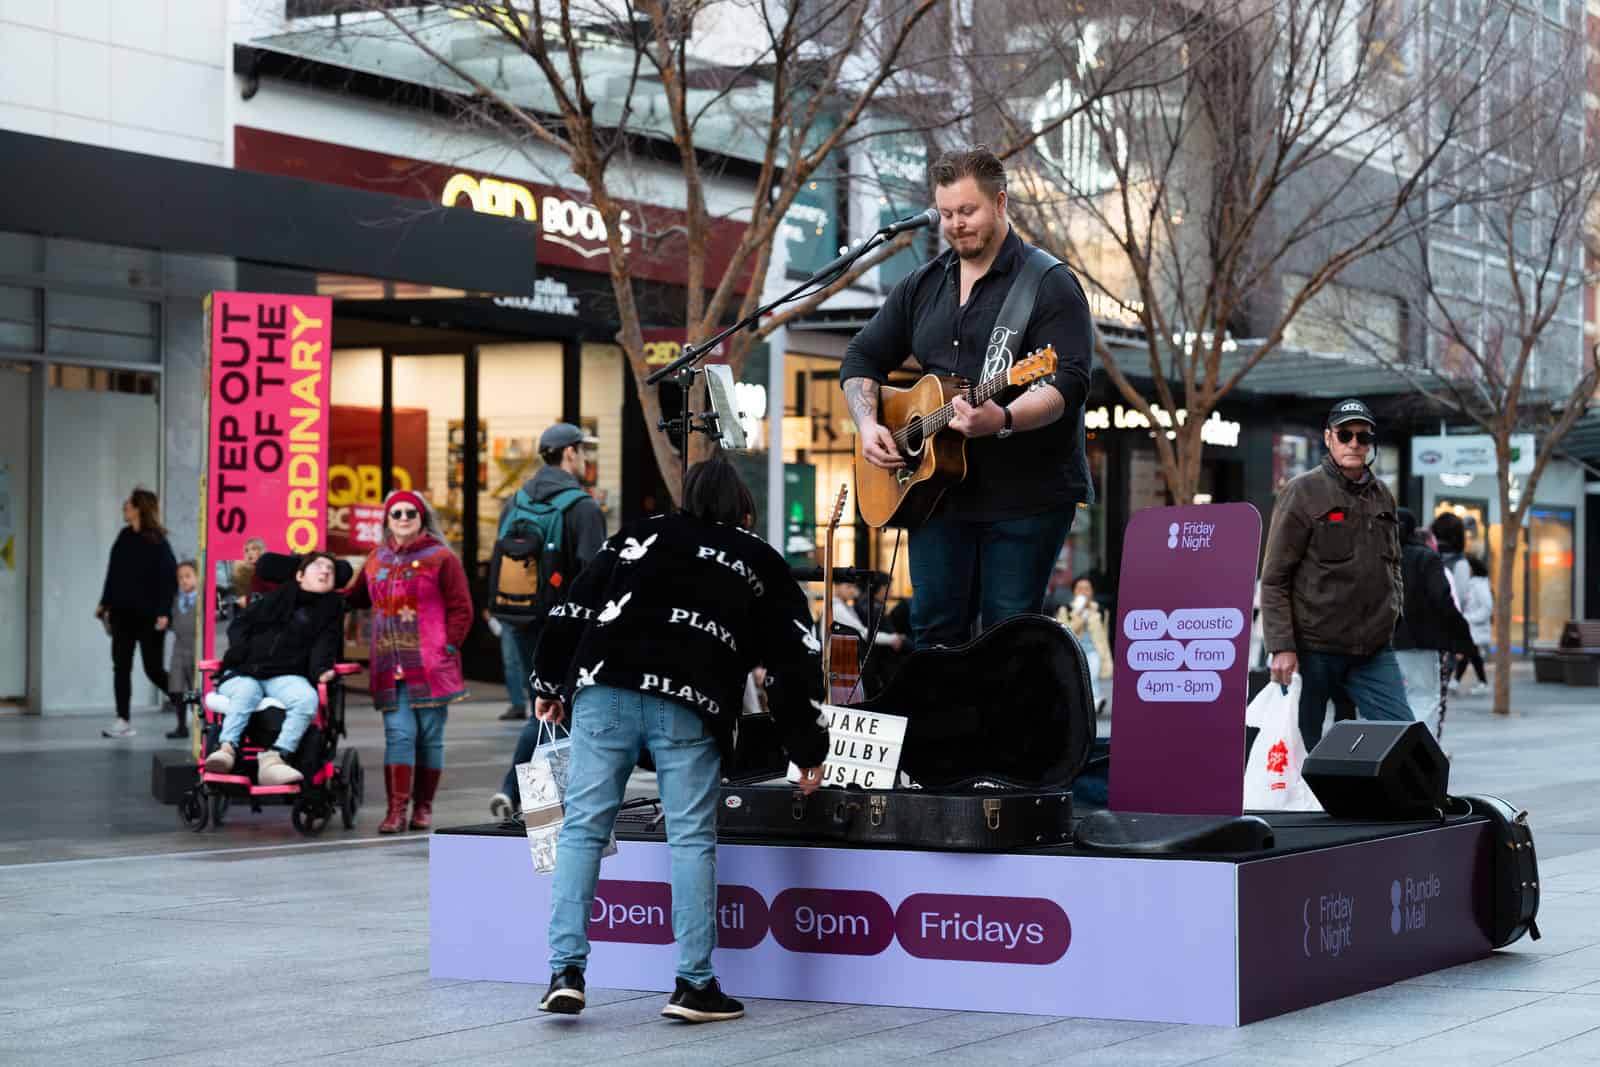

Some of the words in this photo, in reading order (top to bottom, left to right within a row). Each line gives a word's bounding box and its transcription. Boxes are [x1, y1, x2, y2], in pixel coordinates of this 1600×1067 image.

[220, 302, 251, 405] OUT
[256, 304, 286, 397] THE
[254, 410, 284, 473] OF
[286, 304, 323, 555] ORDINARY
[216, 415, 248, 534] STEP
[1181, 536, 1211, 551] Night
[1183, 522, 1215, 537] Friday
[1133, 617, 1158, 631] Live
[1176, 616, 1233, 630] acoustic
[1136, 648, 1175, 661] music
[1194, 648, 1225, 661] from
[828, 712, 879, 735] JAKE
[817, 763, 875, 788] USIC
[1404, 871, 1441, 903] Rundle
[589, 896, 664, 929] Open
[794, 905, 870, 940] 9pm
[920, 911, 1045, 950] Fridays
[1319, 891, 1354, 925] Friday
[1404, 902, 1426, 930] Mall
[1319, 921, 1352, 957] Night
